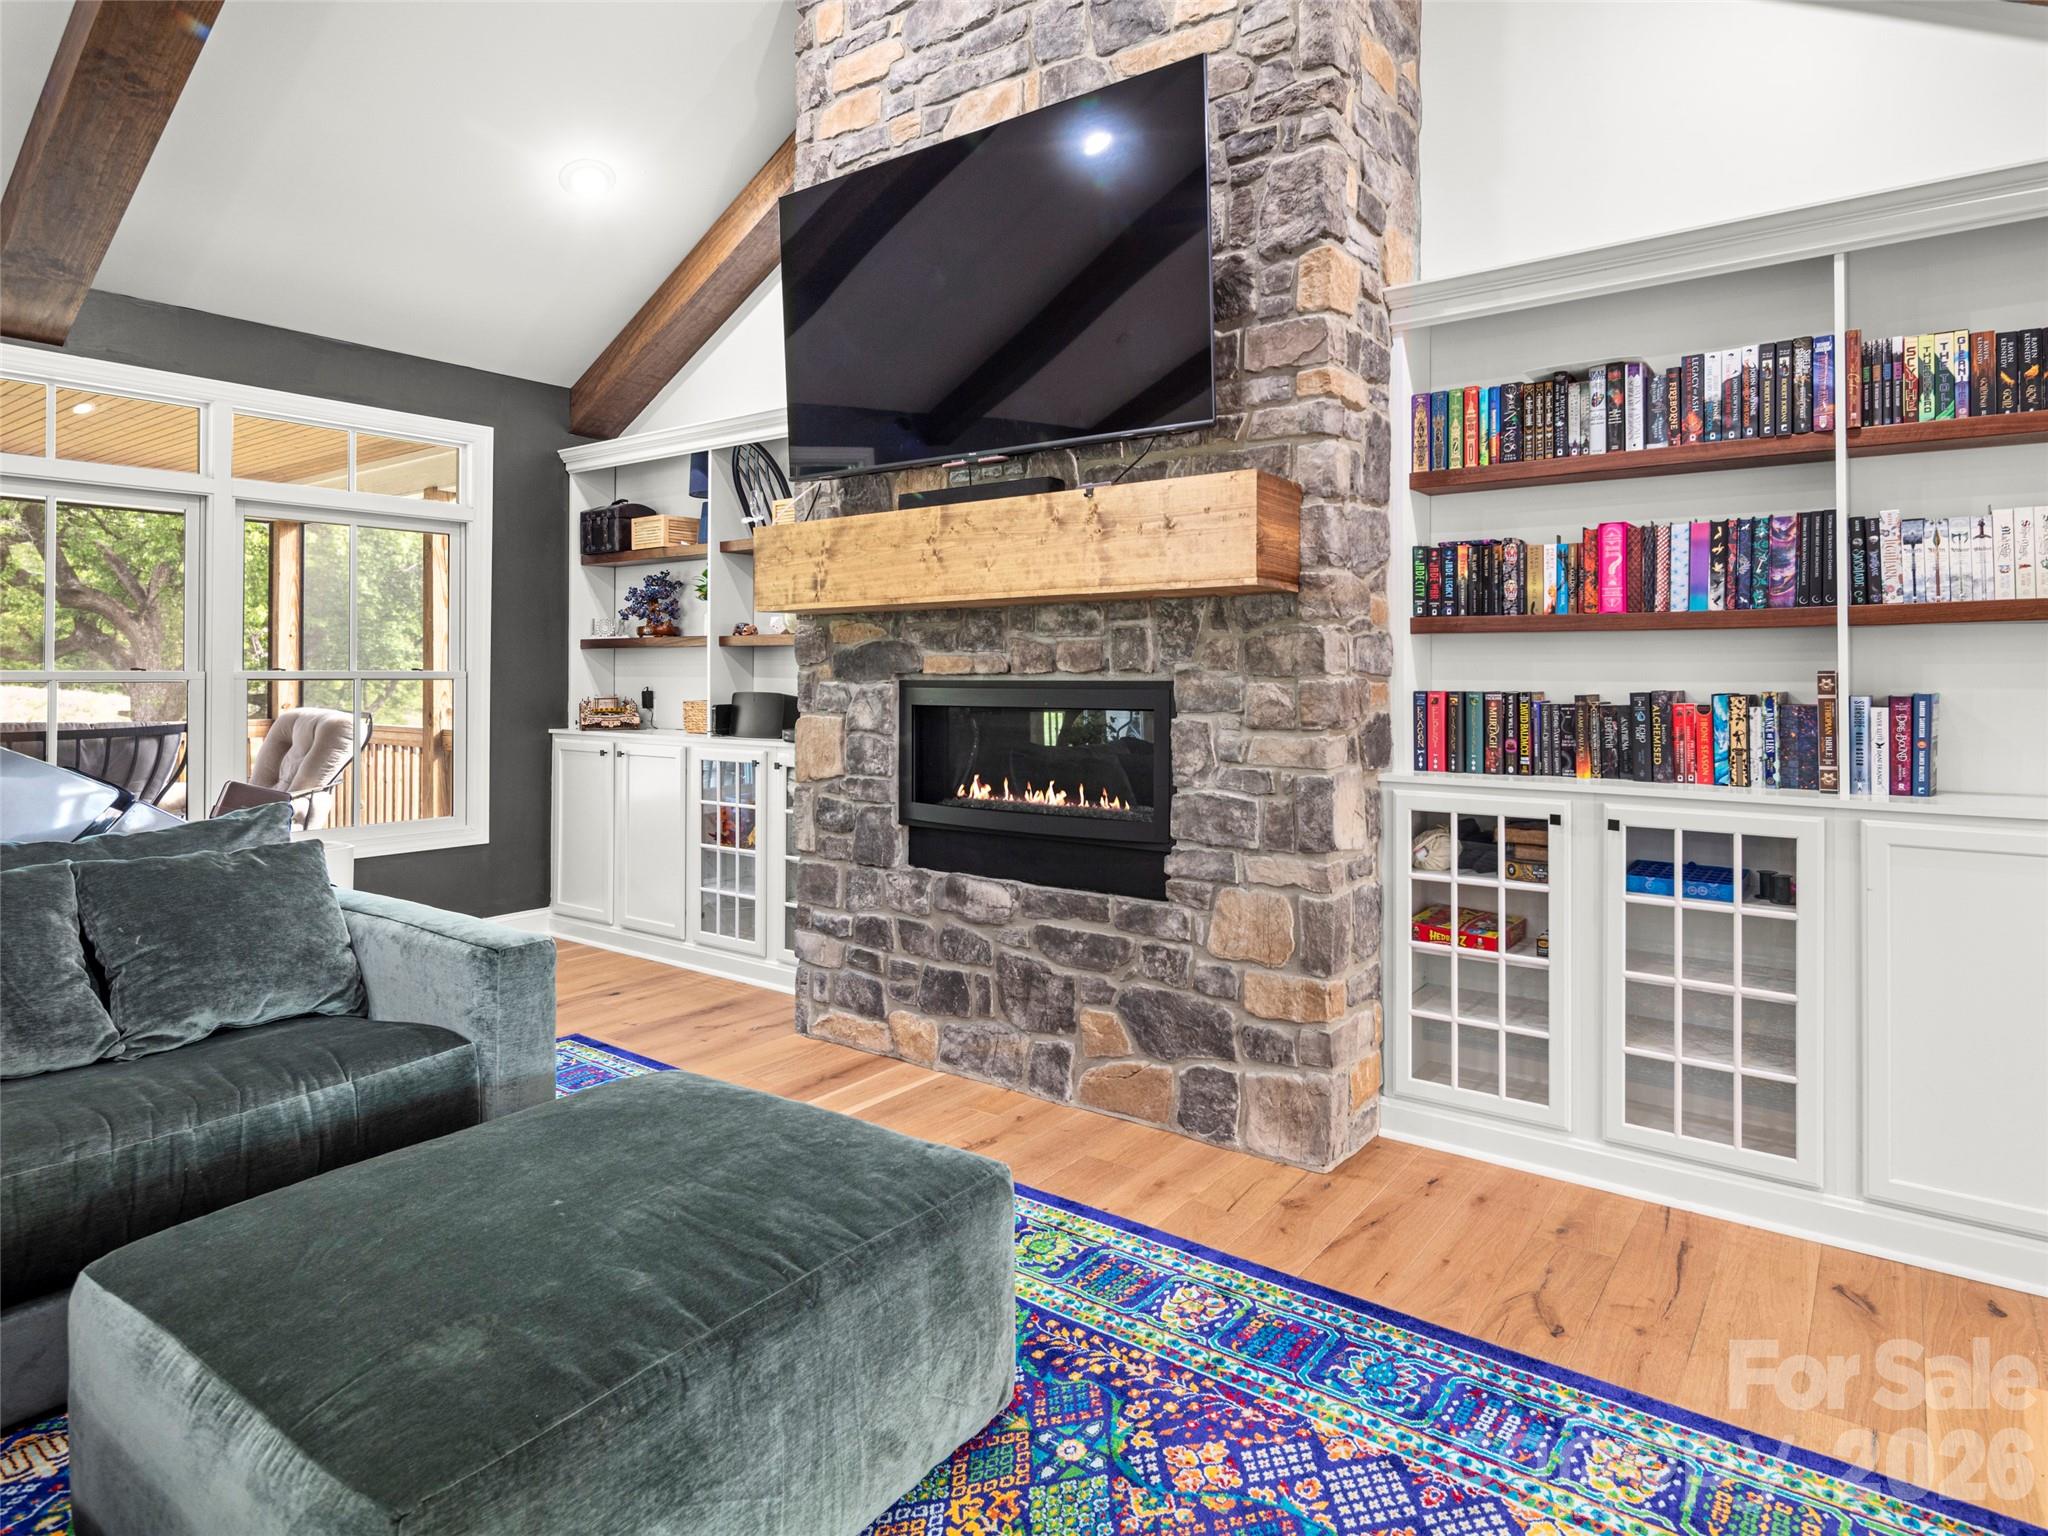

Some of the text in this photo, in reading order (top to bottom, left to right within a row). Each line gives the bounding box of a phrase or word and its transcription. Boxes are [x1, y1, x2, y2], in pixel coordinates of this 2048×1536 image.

[1905, 347, 1917, 411] SCYTHE
[1939, 343, 1950, 410] THE TOLL
[1669, 382, 1677, 430] FIREBORNE
[2002, 388, 2013, 408] GOLD
[1415, 561, 1425, 580] JADE
[1429, 562, 1439, 582] JADE
[1445, 560, 1453, 576] JADE
[1852, 549, 1865, 587] SKYSHADE
[1415, 581, 1425, 597] CITY
[1430, 584, 1439, 600] WAR
[1445, 578, 1453, 598] LEGACY
[1489, 707, 1499, 748] MURTAGH
[1766, 713, 1774, 732] DANCE
[1854, 700, 1864, 728] STARSIDE
[1520, 703, 1528, 755] DAVID BALDACCI
[1620, 716, 1629, 751] ANATHEMA
[1652, 705, 1661, 765] ALCHEMISED
[1824, 702, 1833, 758] ETHIOPIAN BIBLE
[1766, 739, 1774, 753] LIES
[1895, 733, 1907, 761] BOUND
